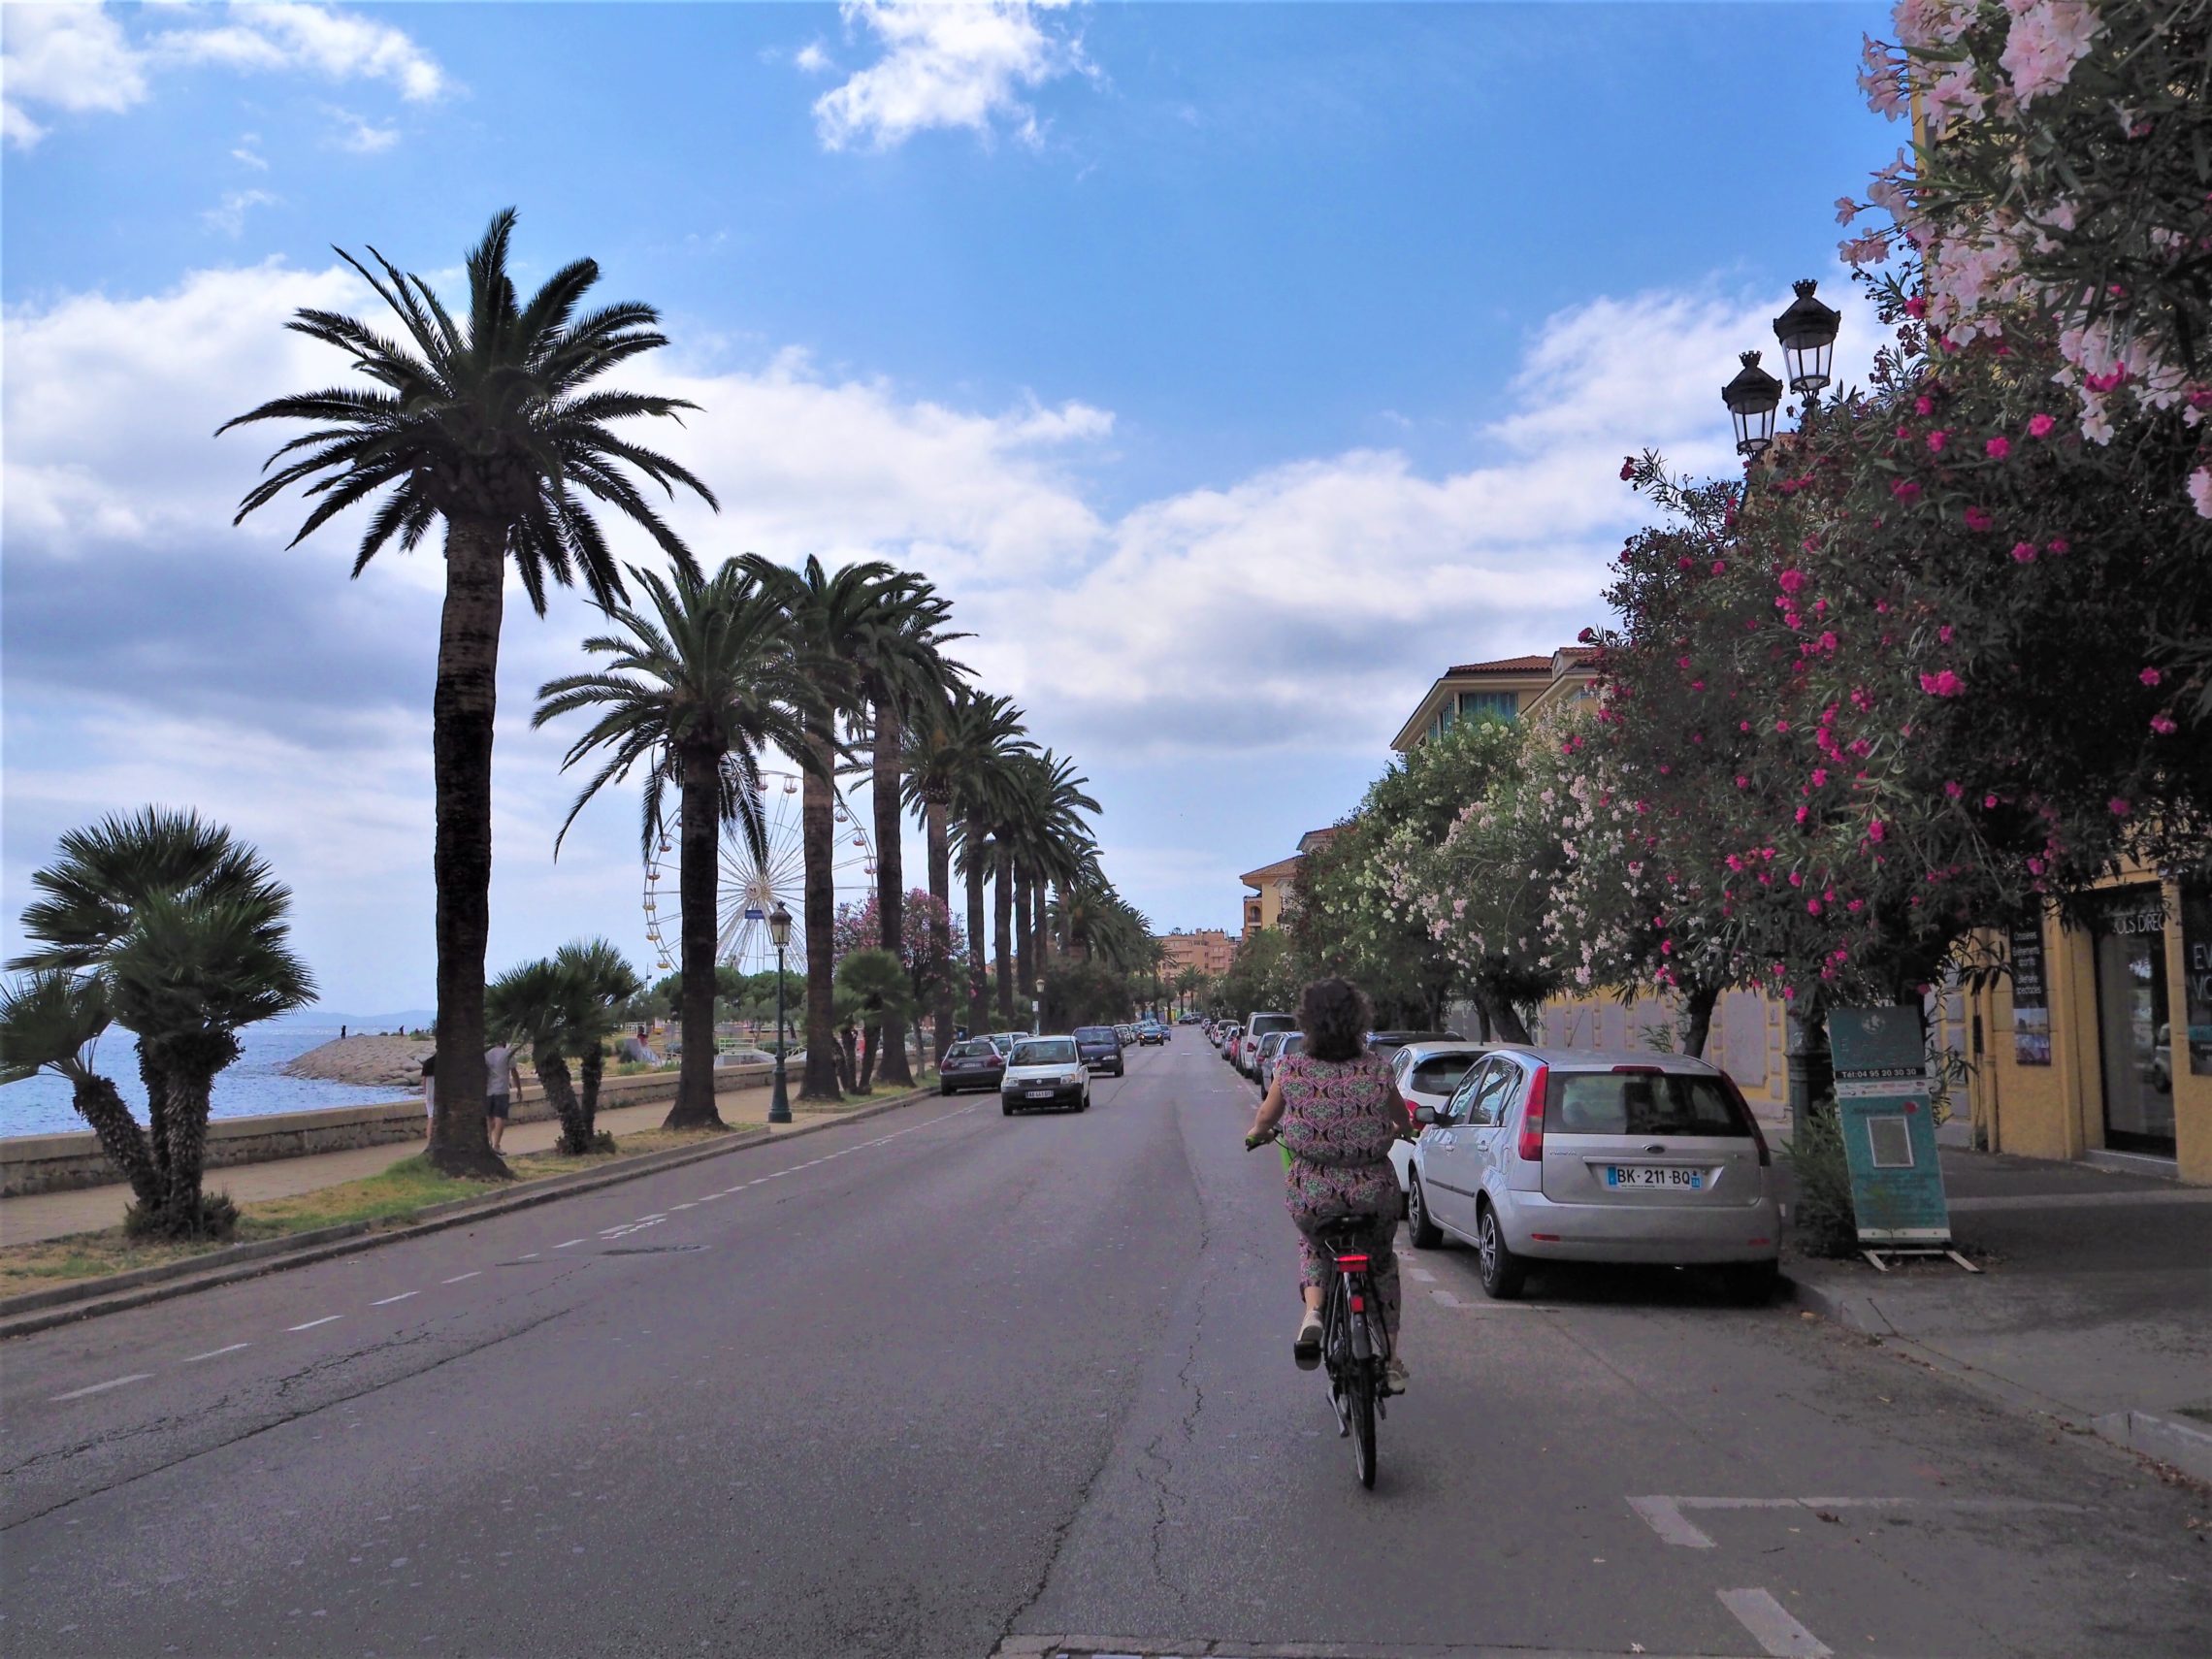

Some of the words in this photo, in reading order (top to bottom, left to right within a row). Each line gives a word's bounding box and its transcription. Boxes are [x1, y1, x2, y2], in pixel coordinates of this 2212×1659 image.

[1869, 1069, 1880, 1078] 95
[1881, 1068, 1892, 1077] 20
[1905, 1067, 1917, 1076] 30
